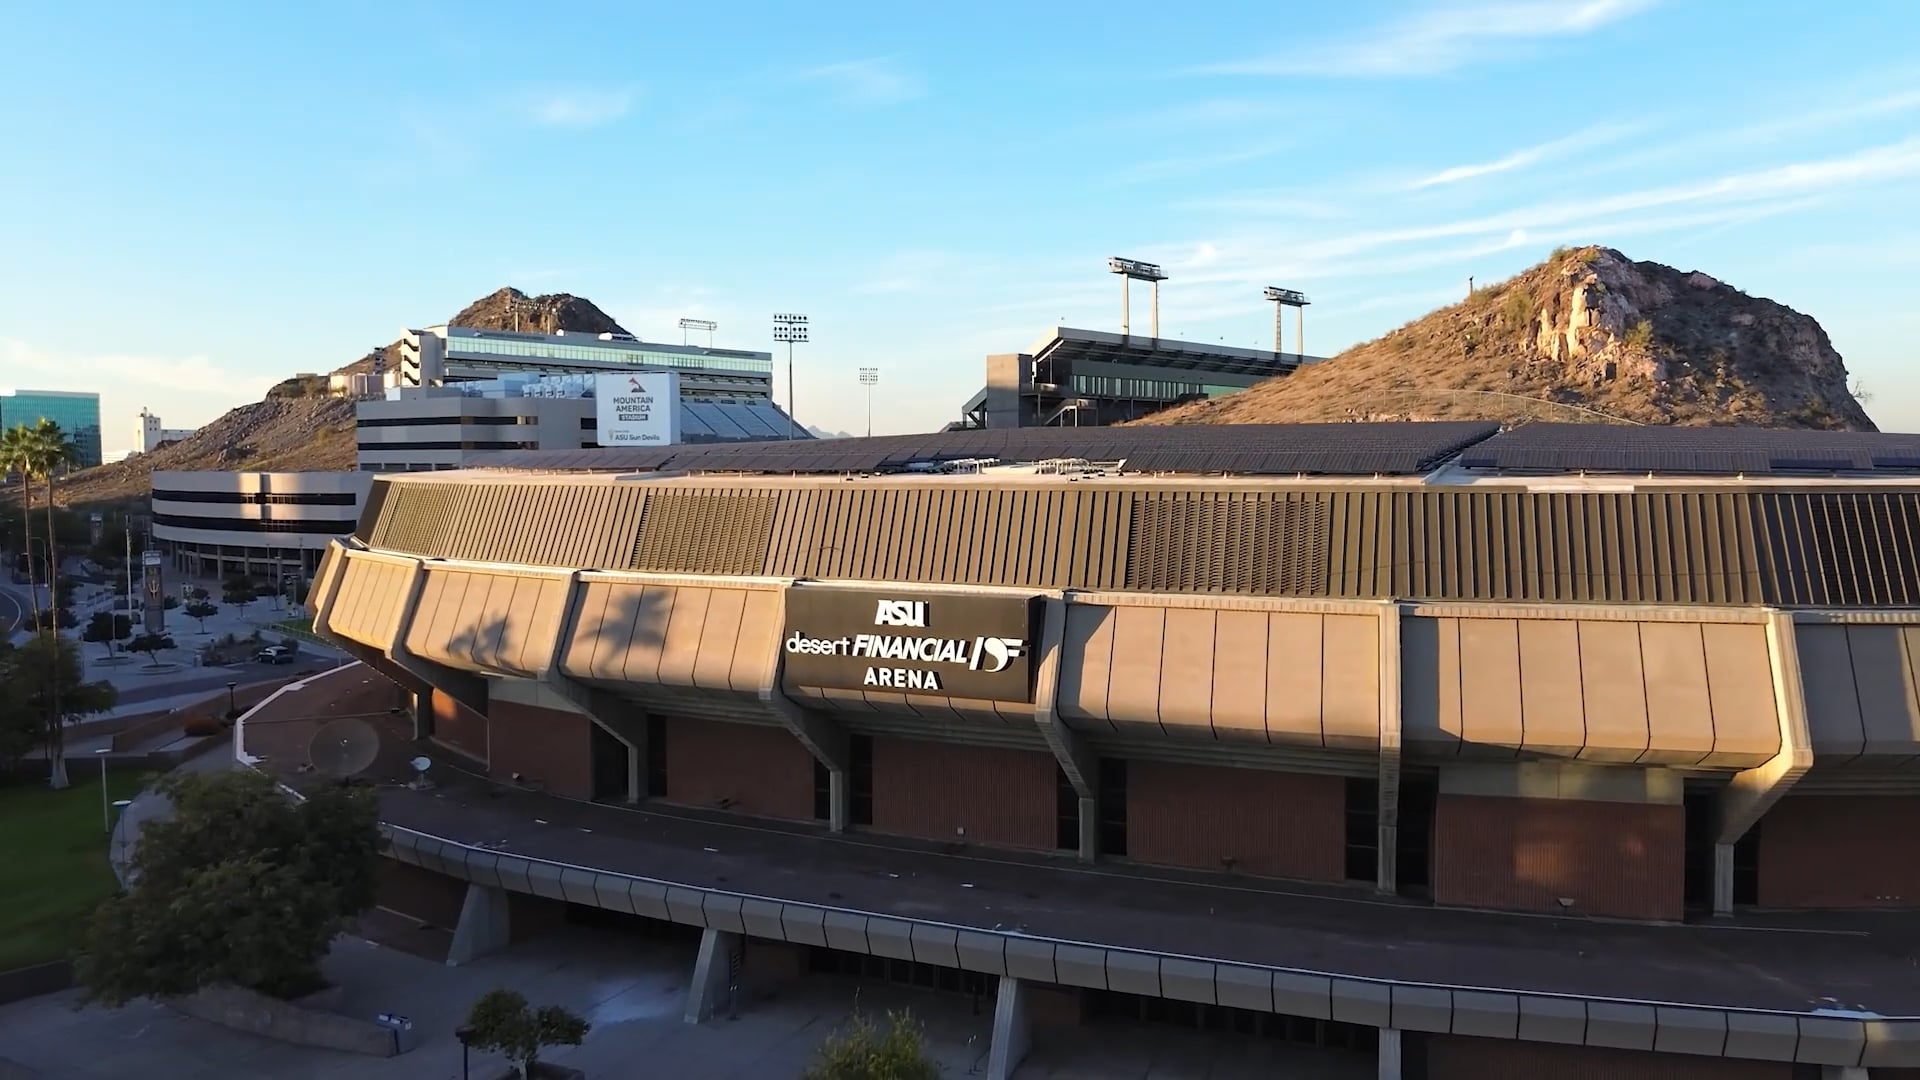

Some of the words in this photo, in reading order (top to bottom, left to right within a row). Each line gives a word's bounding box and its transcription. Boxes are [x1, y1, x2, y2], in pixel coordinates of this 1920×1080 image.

[874, 599, 926, 628] ASU
[786, 631, 850, 656] desert
[852, 634, 968, 663] FINANCIAL
[863, 666, 939, 690] ARENA
